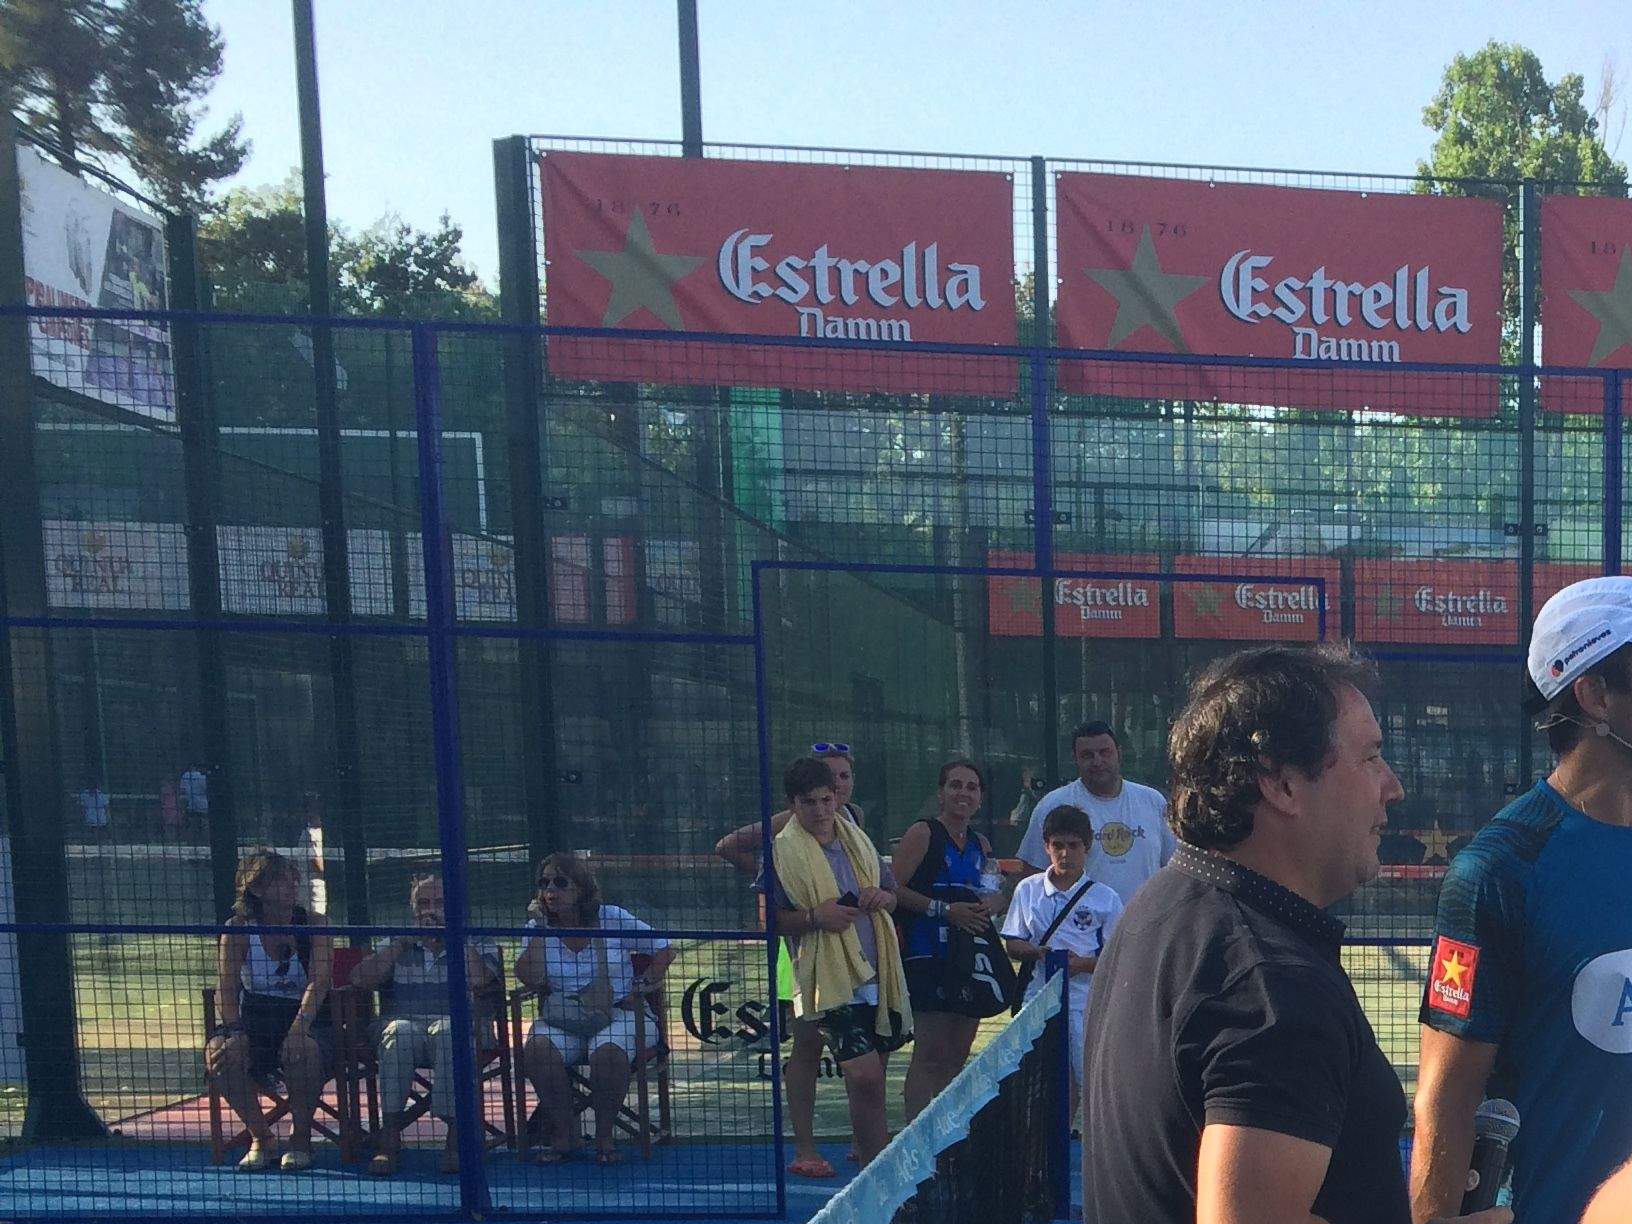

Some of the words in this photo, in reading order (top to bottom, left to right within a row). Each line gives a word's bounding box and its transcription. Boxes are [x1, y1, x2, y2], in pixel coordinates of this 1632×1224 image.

[718, 228, 987, 311] Estrella
[1220, 248, 1473, 334] Estrella
[795, 305, 913, 341] Damm
[1292, 326, 1401, 363] Damm
[1055, 577, 1150, 607] Estrella
[1414, 585, 1509, 613] Estrella
[1262, 609, 1304, 623] Damm
